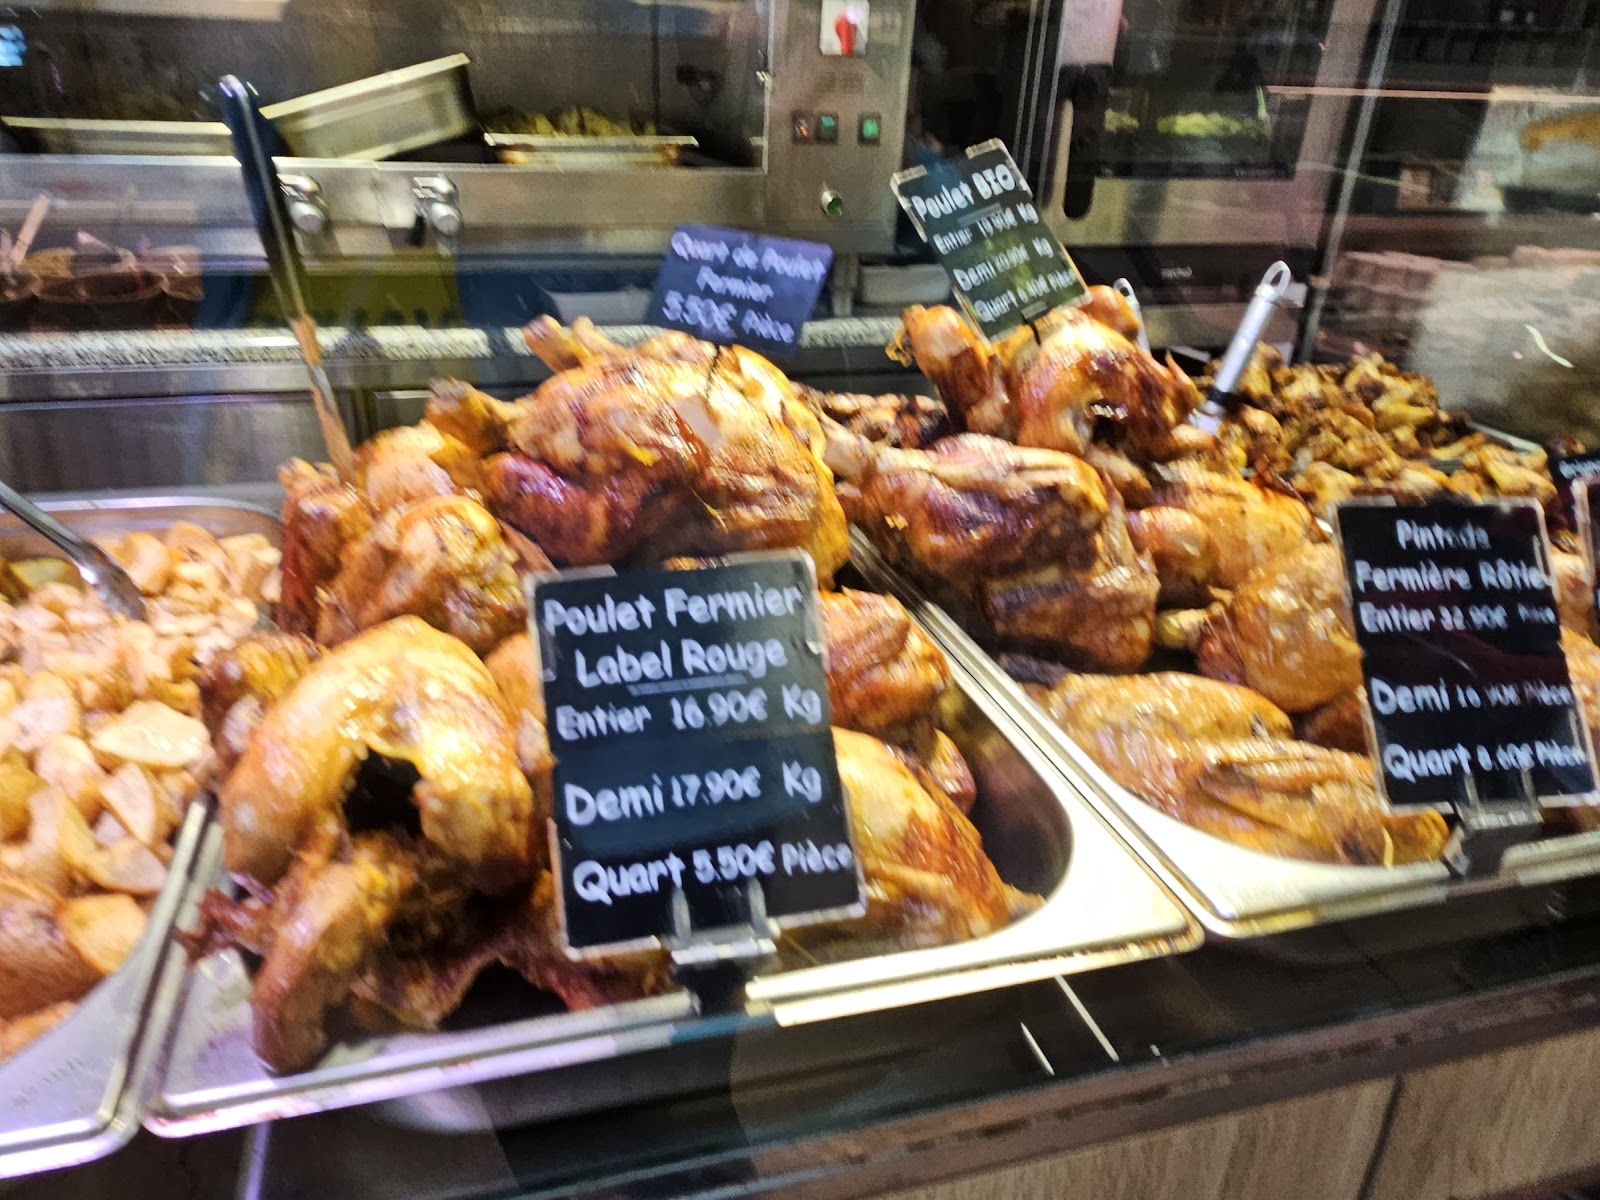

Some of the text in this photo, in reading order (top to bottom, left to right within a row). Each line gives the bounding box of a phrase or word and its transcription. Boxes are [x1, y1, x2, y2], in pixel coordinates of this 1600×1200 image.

[911, 164, 1015, 222] Poulet BIO
[1016, 202, 1039, 224] Kg
[953, 261, 997, 291] Demi
[1032, 236, 1054, 258] Kg
[974, 289, 1019, 322] Quart
[543, 582, 802, 636] Poulet Fermier
[1358, 601, 1436, 633] Entier
[574, 638, 788, 688] Label Rouge
[555, 683, 823, 740] Entier 16.90€ Kg
[1371, 677, 1451, 715] Demi
[1383, 742, 1471, 783] Quart
[564, 759, 823, 826] Demi 17.90€ Kg
[572, 851, 687, 905] Quart
[691, 839, 777, 884] 5.50€
